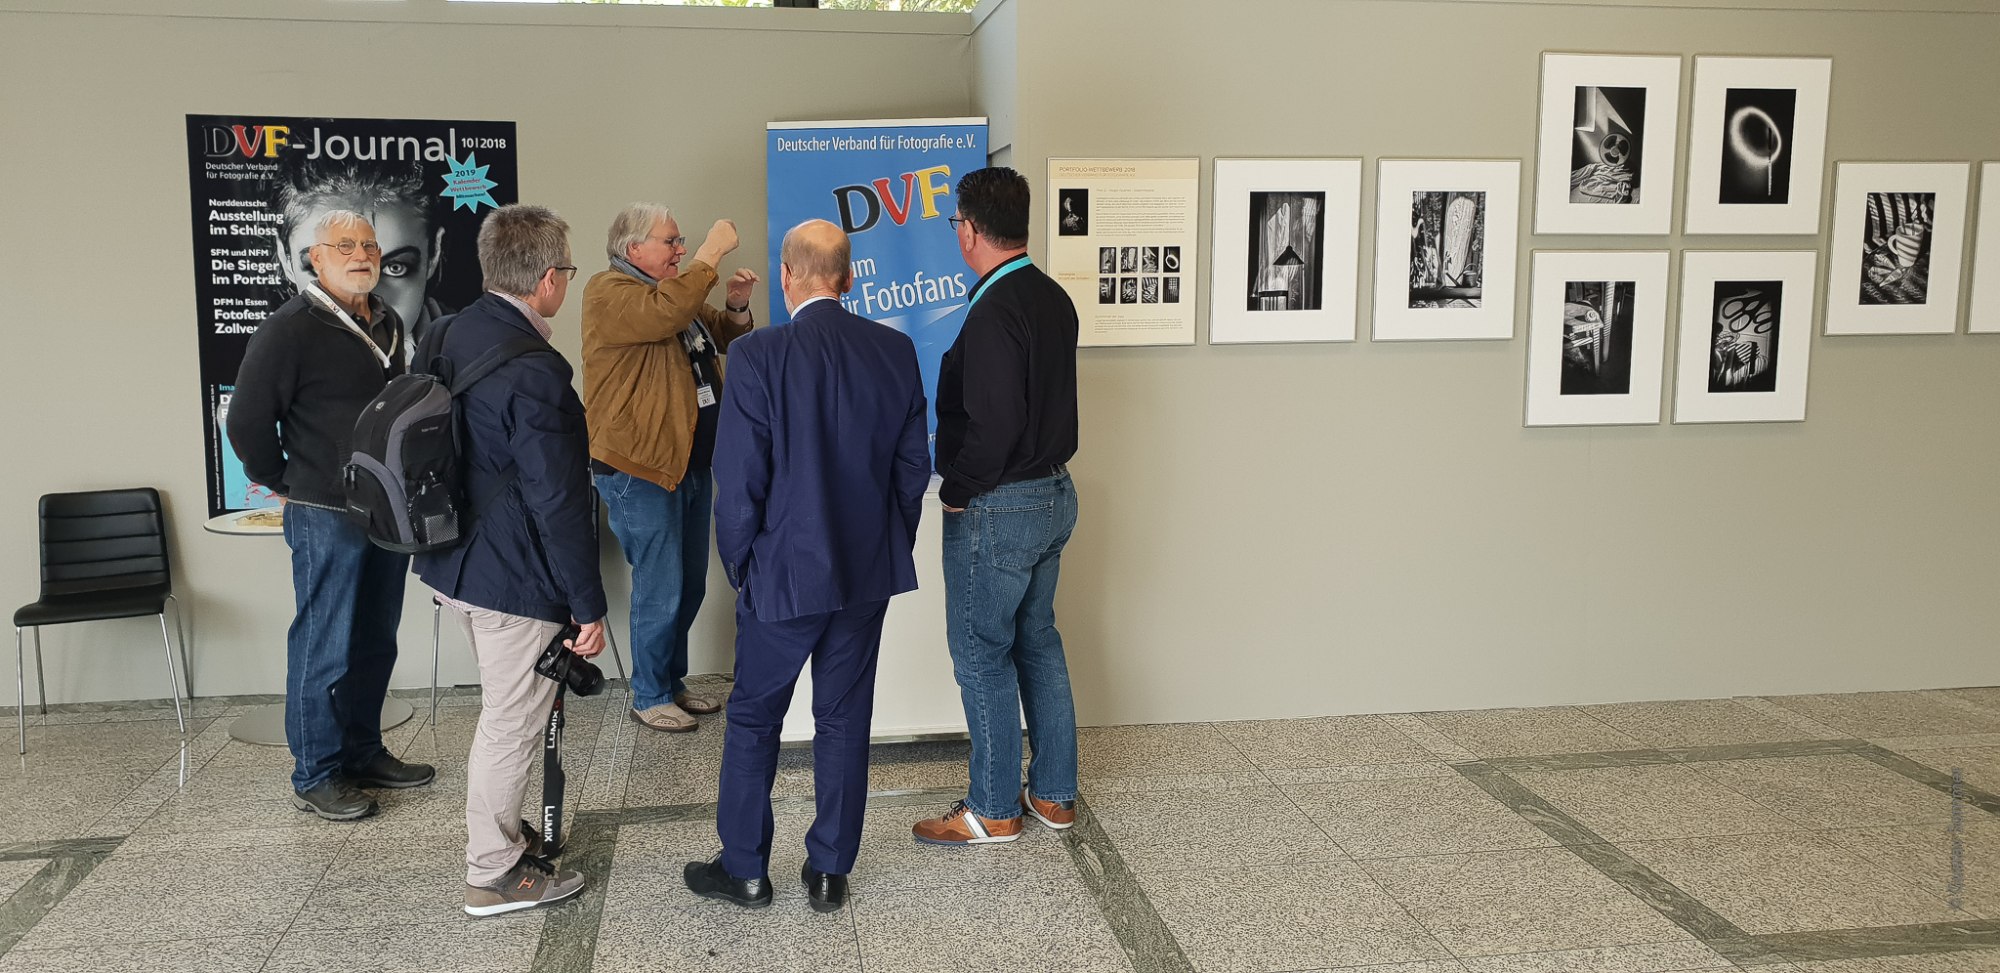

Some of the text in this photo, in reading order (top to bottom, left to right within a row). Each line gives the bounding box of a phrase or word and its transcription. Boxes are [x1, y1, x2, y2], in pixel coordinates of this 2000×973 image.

[777, 134, 976, 153] Deutscher Verband für Fotografie e.V.
[205, 162, 278, 171] Deutscher Verband
[206, 171, 275, 182] für Fotografie e.V.
[209, 199, 267, 207] Norddeutsche
[832, 164, 951, 236] DVF
[209, 209, 284, 225] Ausstellung
[210, 224, 278, 236] im Schloss
[210, 248, 269, 257] SFM und NFM
[212, 259, 280, 274] Die Sieger
[212, 274, 282, 286] im Porträt
[840, 271, 967, 315] ür Fotofans
[214, 308, 267, 320] Fotofest
[547, 710, 559, 749] LUMIX
[544, 806, 555, 842] LUMIX
